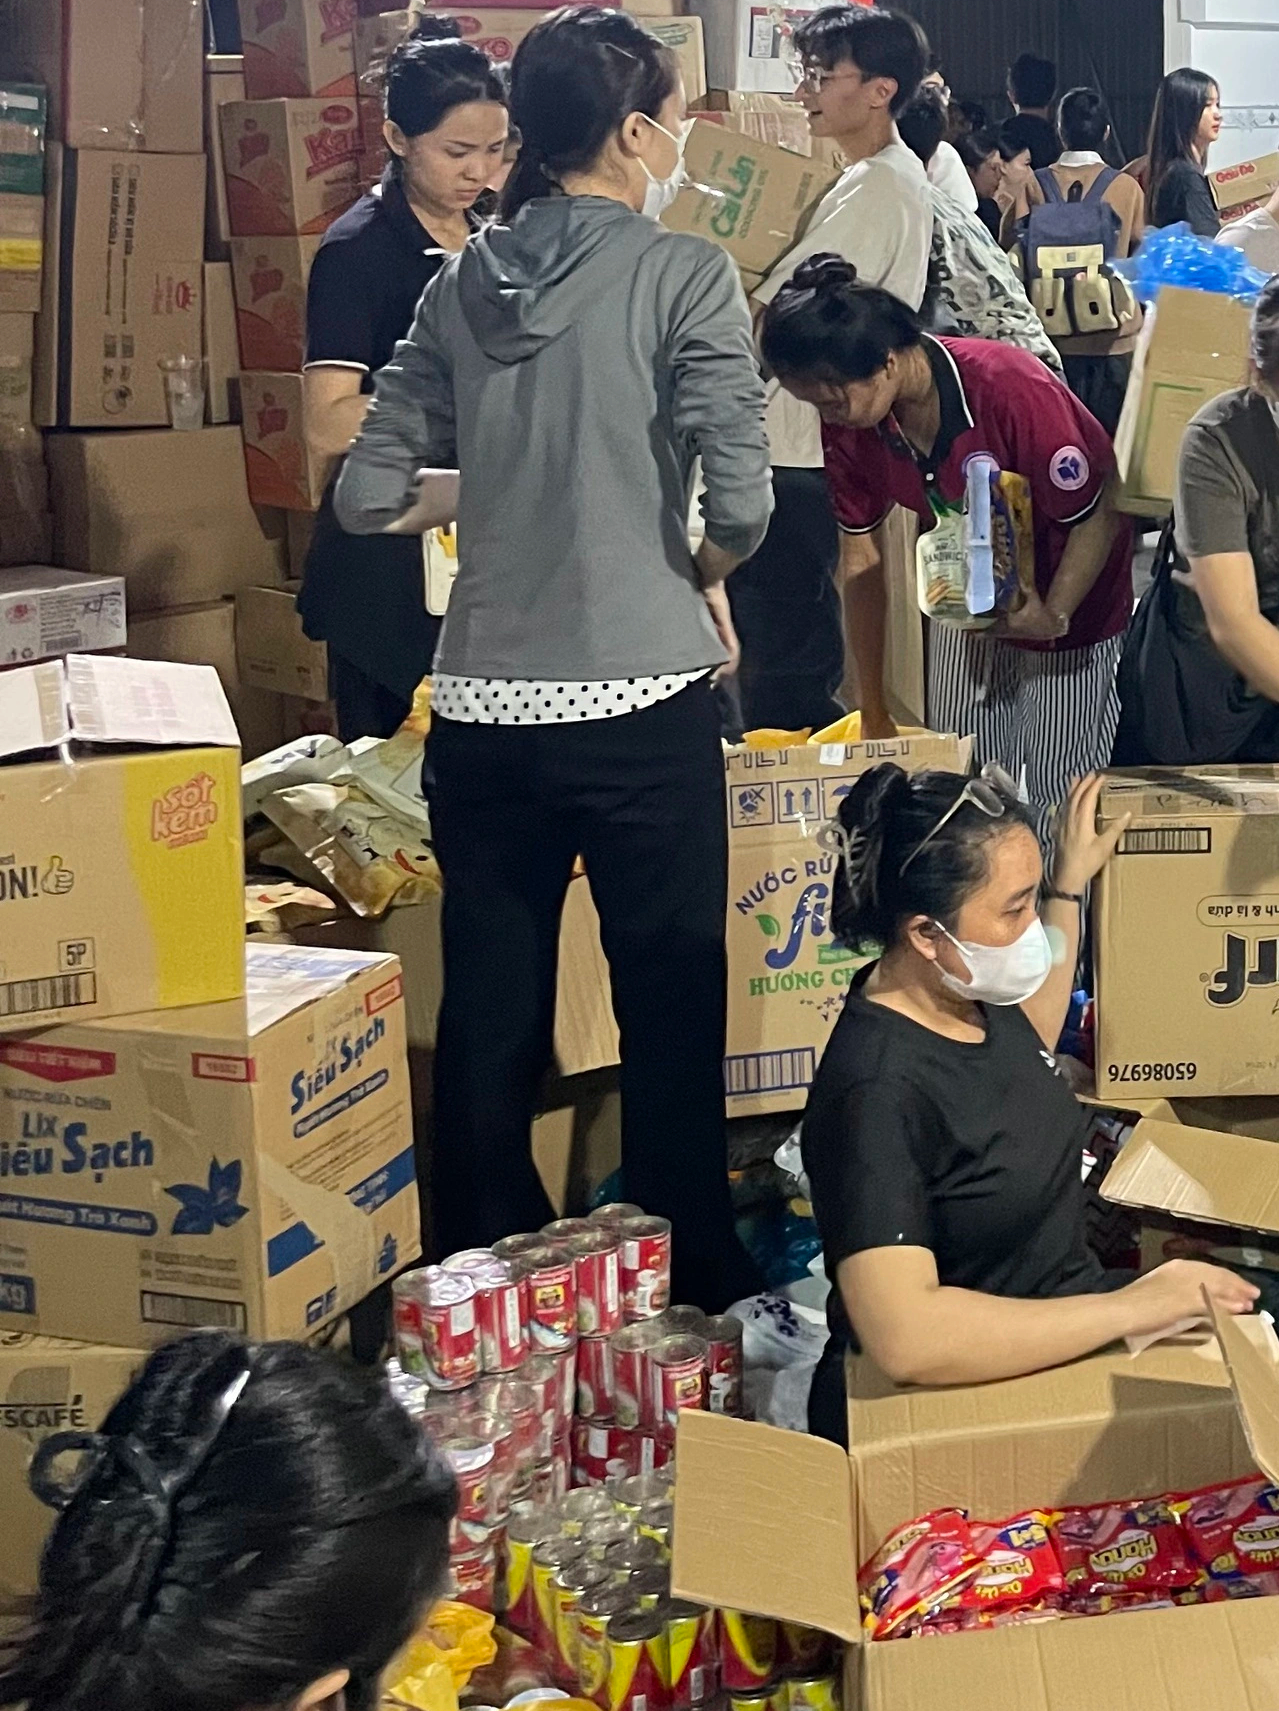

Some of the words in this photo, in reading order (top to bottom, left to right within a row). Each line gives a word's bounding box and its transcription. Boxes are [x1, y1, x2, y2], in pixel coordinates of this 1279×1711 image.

[1207, 904, 1233, 919] dứa
[1236, 904, 1249, 919] lá
[1251, 904, 1262, 916] &
[749, 969, 825, 997] HƯƠNG
[1107, 1061, 1198, 1083] 65086976
[0, 1141, 53, 1177] iêu
[61, 1122, 154, 1183] Sạch
[0, 1394, 86, 1428] SCAFÉ
